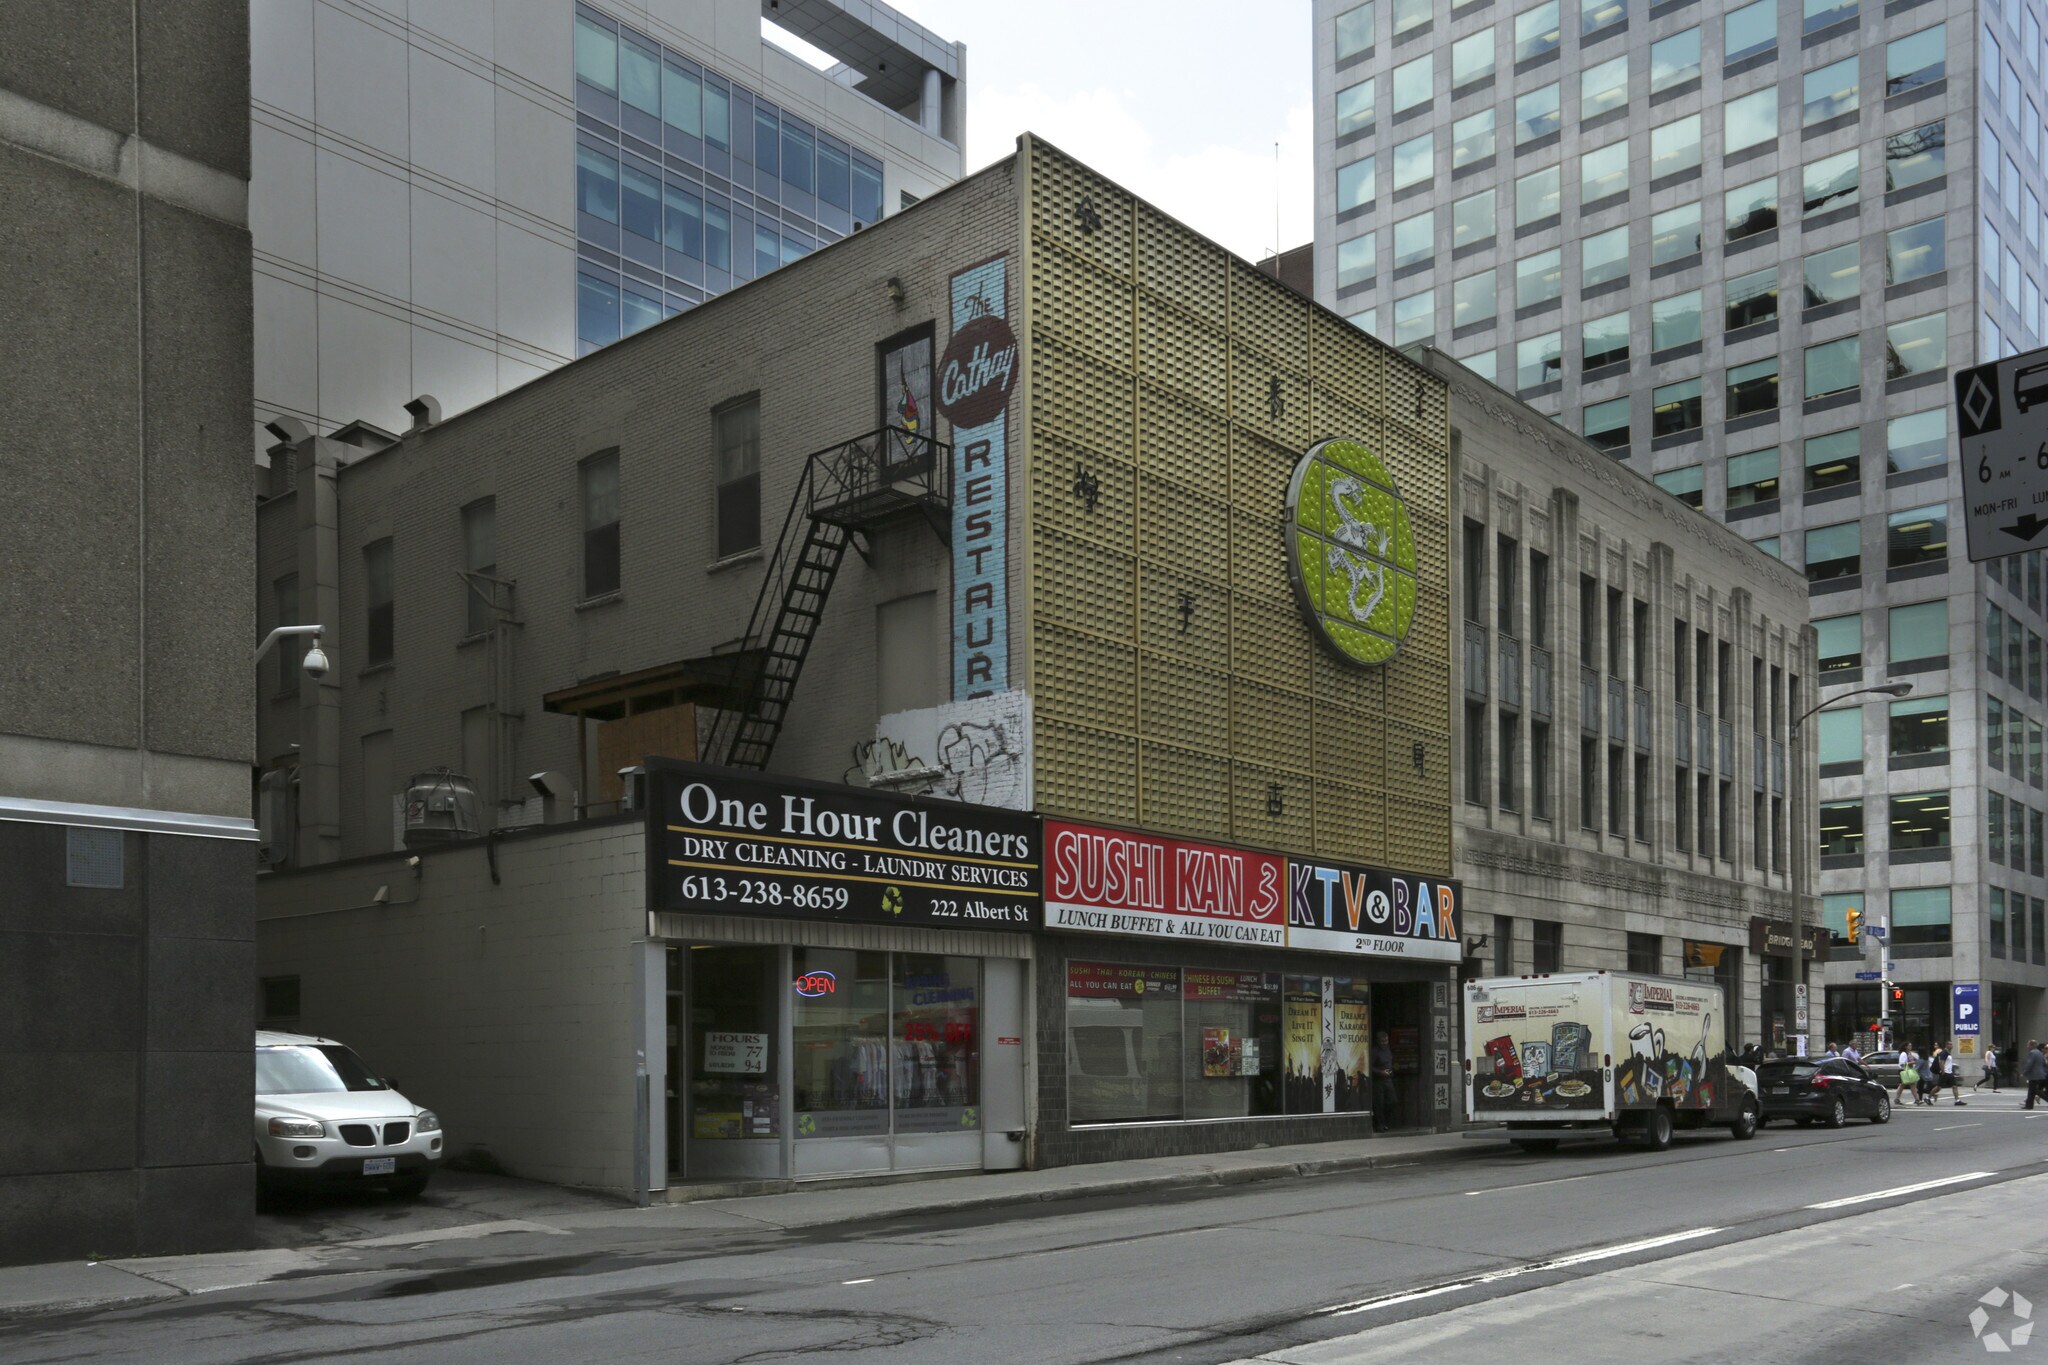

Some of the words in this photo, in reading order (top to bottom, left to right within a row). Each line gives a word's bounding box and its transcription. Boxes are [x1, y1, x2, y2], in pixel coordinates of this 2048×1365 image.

[941, 341, 1016, 405] Cathay
[1978, 456, 1992, 484] 6
[1999, 470, 2011, 479] AM
[1974, 497, 2018, 518] MON-FRI
[963, 437, 993, 700] RESTAUR
[680, 783, 768, 830] One
[781, 795, 881, 842] Hour
[892, 810, 1029, 860] Cleaners
[684, 837, 730, 860] DRY
[735, 843, 847, 870] CLEANING
[863, 854, 947, 880] LAUNDRY
[951, 864, 1029, 887] SERVICES
[1055, 829, 1165, 909] SUSHI
[1176, 847, 1244, 917] KAN
[1249, 862, 1279, 920] 3
[682, 875, 849, 910] 613-238-8659
[1288, 862, 1367, 931] KTV
[1392, 877, 1458, 941] BAR
[930, 899, 959, 917] 222
[963, 901, 1011, 921] Albert
[1014, 904, 1029, 922] St
[1057, 909, 1108, 928] LUNCH
[1110, 915, 1163, 933] BUFFET
[1165, 919, 1176, 934] &
[1180, 921, 1205, 936] ALL
[1208, 924, 1234, 939] YOU
[1235, 926, 1258, 941] CAN
[1260, 929, 1283, 943] EAT
[1373, 939, 1405, 952] FLOOR
[1767, 934, 1814, 950] BRIDGEAD
[1070, 967, 1091, 975] SUSHI
[1096, 968, 1113, 976] THAI
[1118, 969, 1146, 978] KOREAN
[1150, 971, 1177, 980] CHINESE
[1184, 974, 1210, 984] CHINESE
[1217, 975, 1235, 985] SUSHI
[796, 975, 836, 994] OPEN
[1069, 980, 1083, 988] ALL
[1086, 980, 1100, 989] YOU
[1103, 981, 1117, 989] CAN
[1120, 982, 1132, 990] EAT
[1198, 985, 1221, 996] BUFFET
[1644, 983, 1674, 1002] IMPERIAL
[912, 987, 976, 1006] CLEANING
[1311, 1008, 1318, 1017] IT
[1493, 1004, 1526, 1015] IMPERIAL
[1959, 1003, 1974, 1020] P
[905, 1022, 942, 1042] 25%
[944, 1022, 974, 1042] OFF
[1306, 1021, 1314, 1030] IT
[1955, 1023, 1979, 1031] PUBLIC
[712, 1034, 760, 1044] HOURS
[1307, 1034, 1314, 1043] IT
[1348, 1034, 1369, 1044] FLOOR
[746, 1045, 763, 1058] 7-7
[745, 1059, 761, 1072] 9-4
